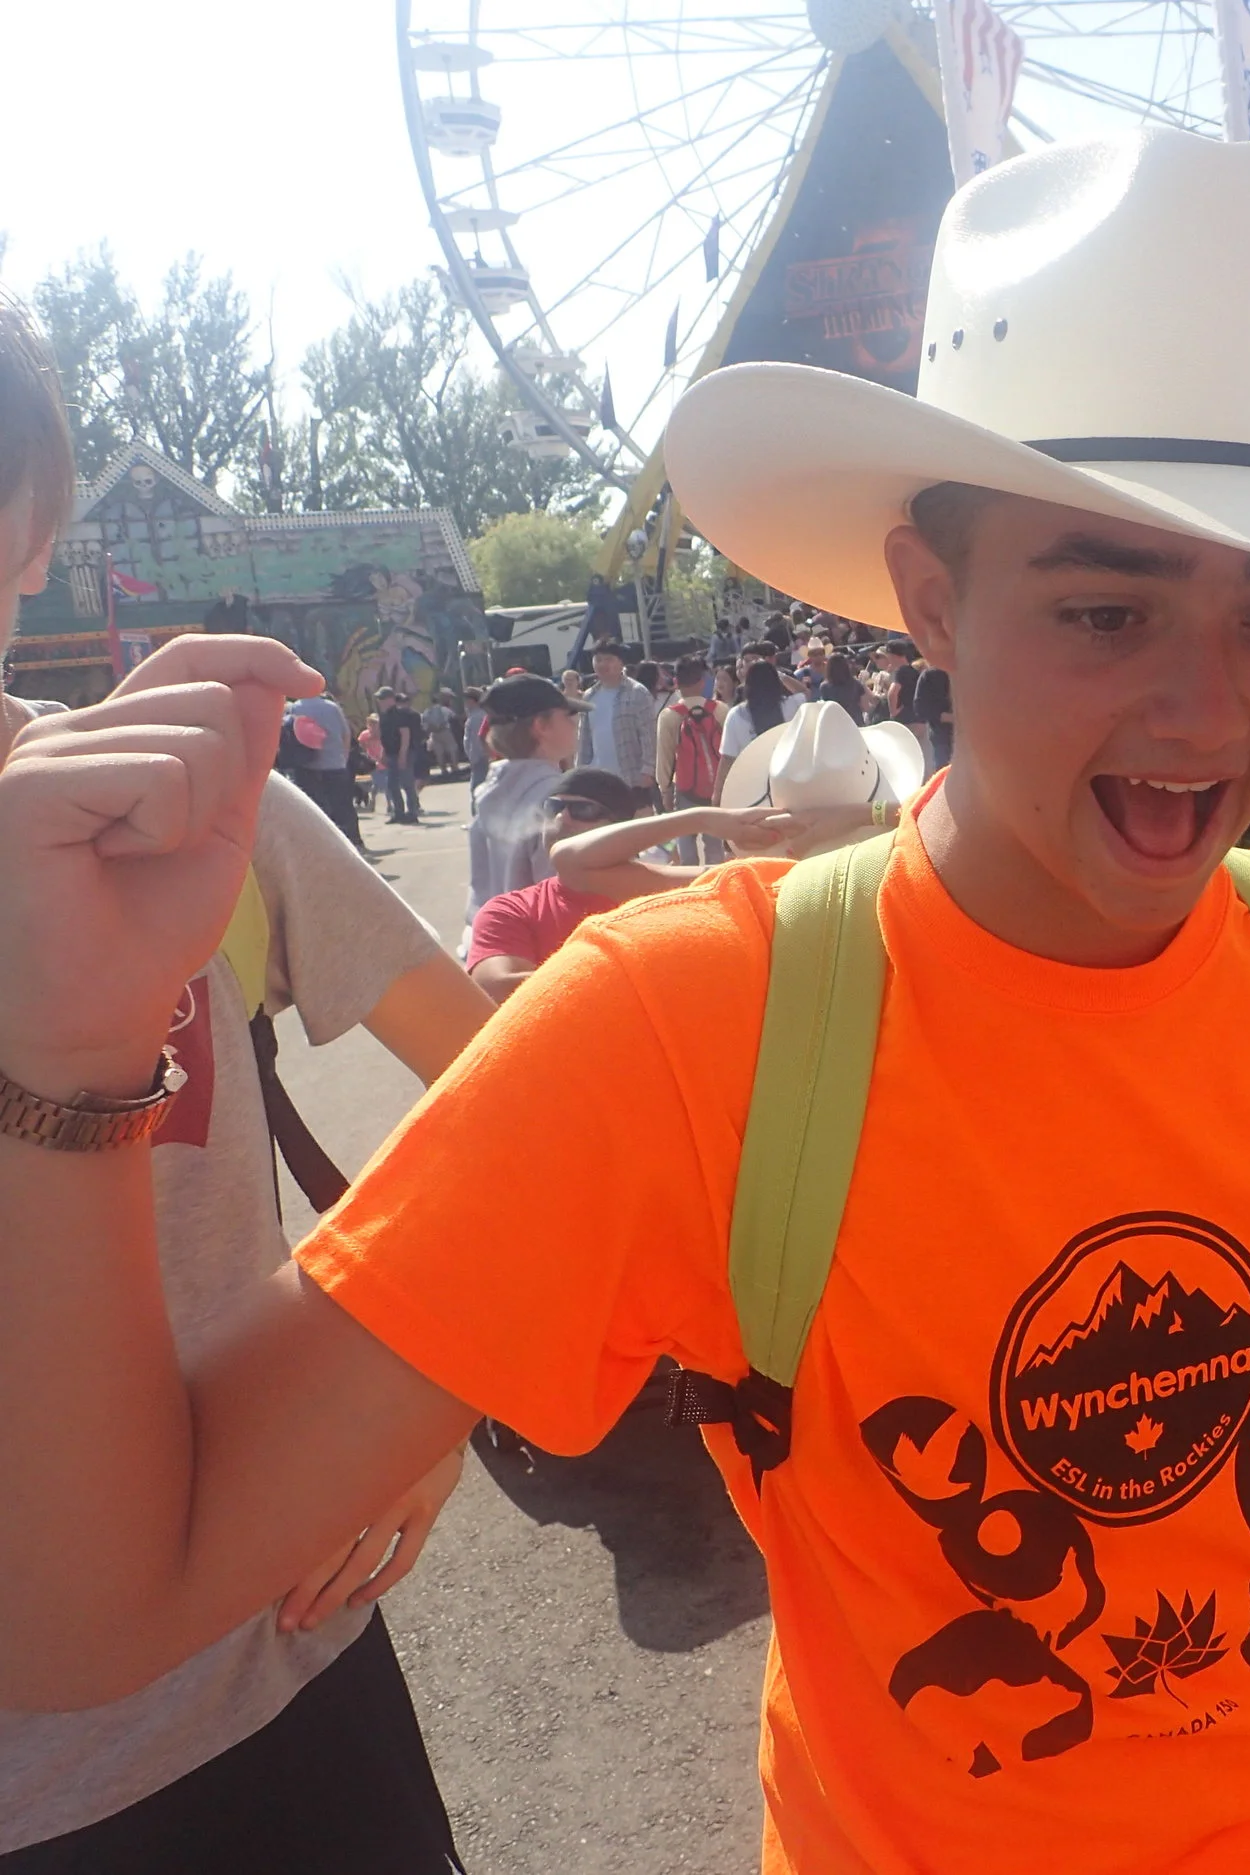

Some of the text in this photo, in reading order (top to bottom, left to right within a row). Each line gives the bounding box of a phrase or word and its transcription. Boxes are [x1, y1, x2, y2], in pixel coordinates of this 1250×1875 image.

[1051, 1413, 1231, 1500] ESL in the Rockies
